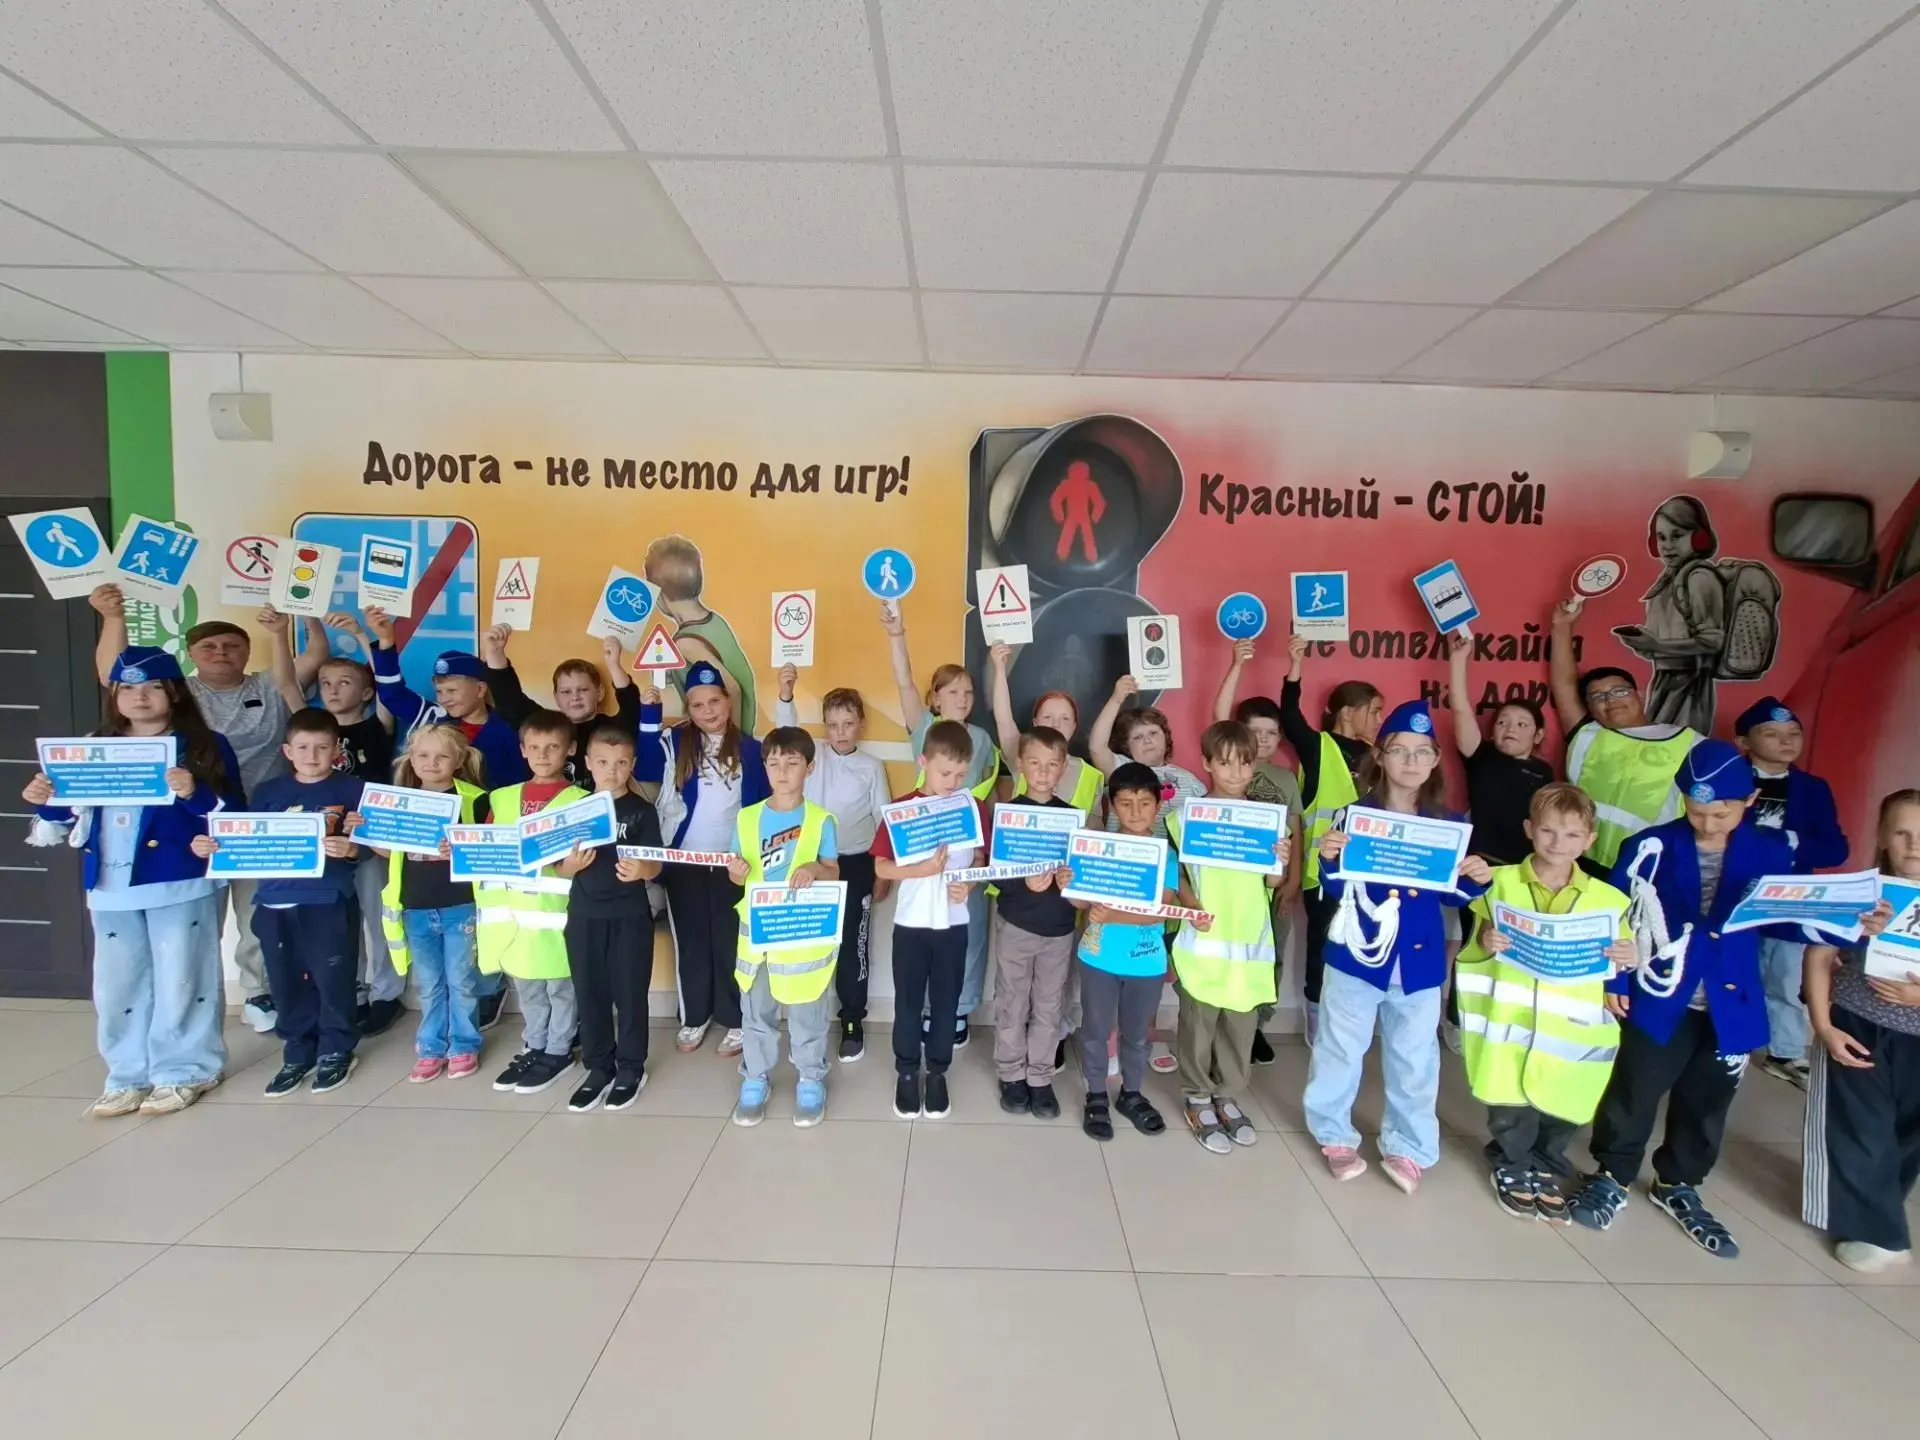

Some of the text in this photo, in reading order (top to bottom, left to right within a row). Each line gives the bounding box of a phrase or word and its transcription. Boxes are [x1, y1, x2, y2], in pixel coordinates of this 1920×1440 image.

[363, 441, 501, 490] Дорога
[546, 456, 590, 488] не
[603, 458, 738, 493] место
[750, 462, 821, 499] для
[834, 455, 911, 502] игр!
[1199, 473, 1380, 524] Красный
[1427, 471, 1546, 528] СТОЙ!
[139, 603, 157, 639] КЛАС
[1000, 812, 1038, 828] ПДД
[1190, 806, 1233, 822] ПДД
[453, 831, 494, 843] ПДД
[617, 847, 734, 865] ВСЕ ЭТИ ПРАВИЛА
[945, 859, 1065, 881] ТЫ ЗНАЙ И НИКОГДА
[1762, 885, 1828, 900] ПДД
